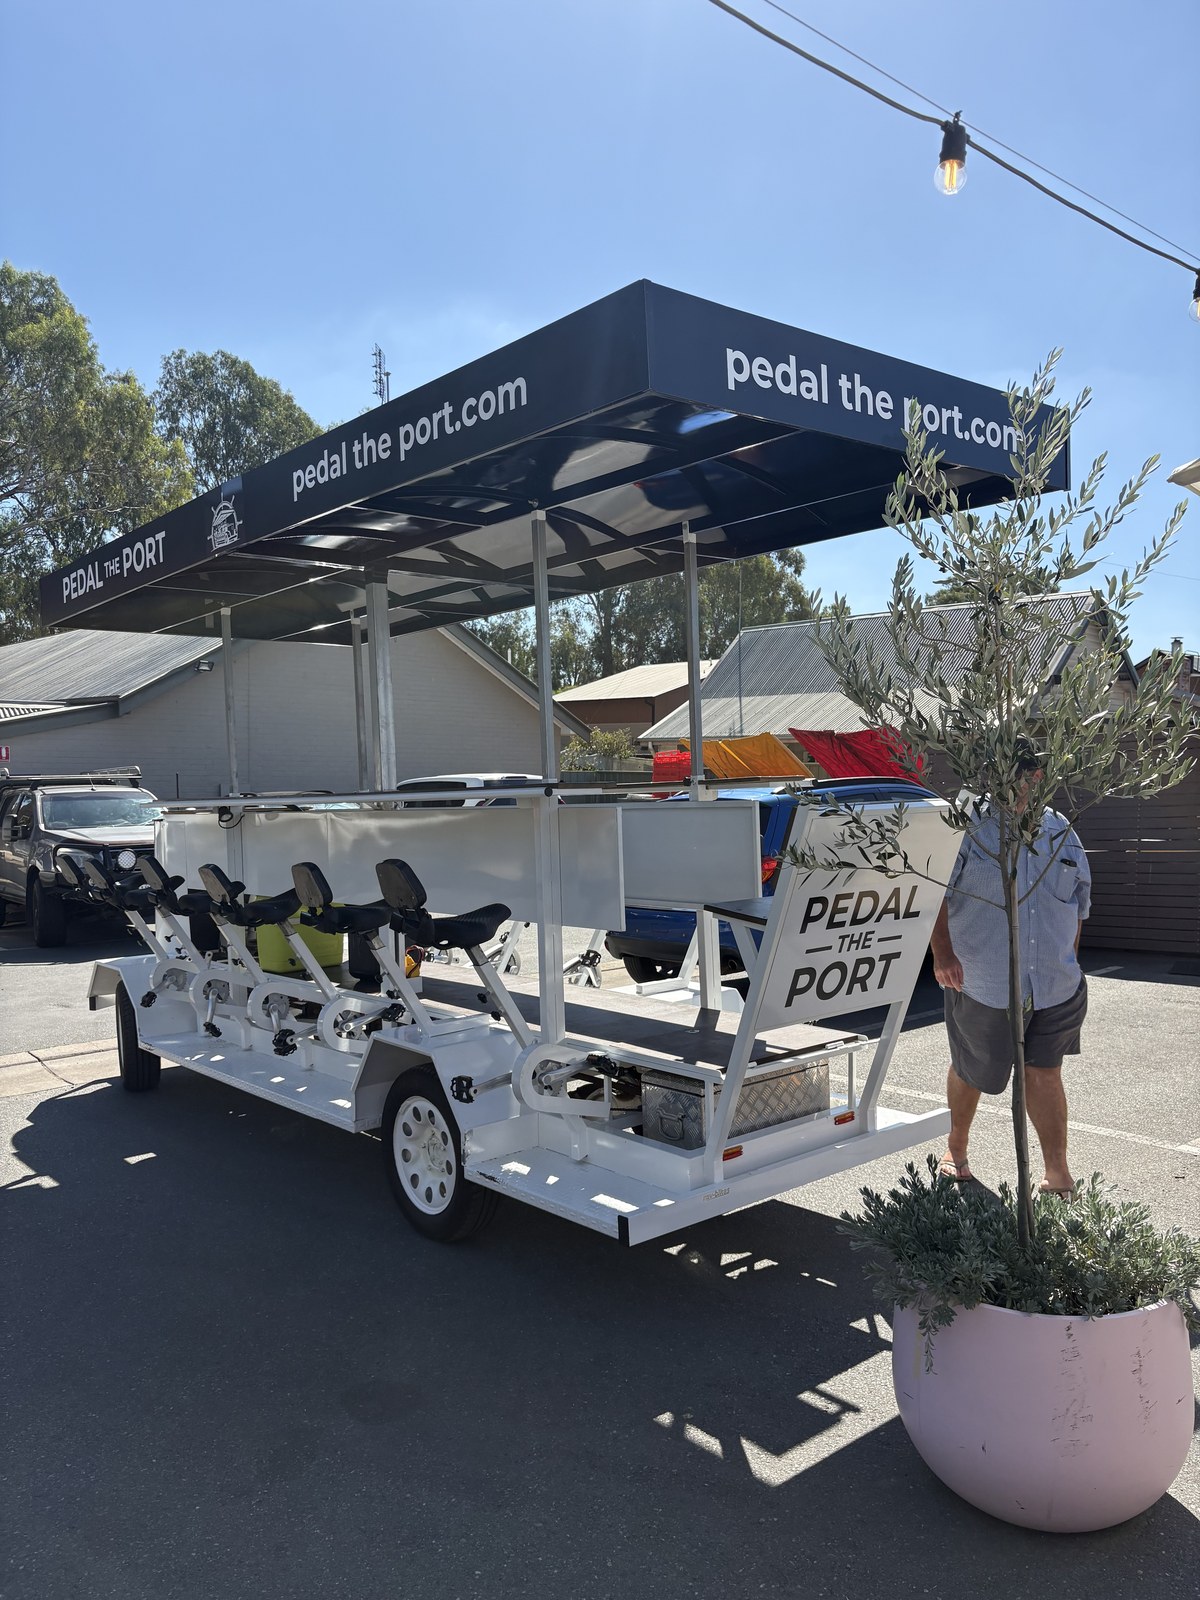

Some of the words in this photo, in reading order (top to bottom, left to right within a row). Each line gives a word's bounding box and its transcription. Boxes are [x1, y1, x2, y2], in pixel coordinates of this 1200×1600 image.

[726, 348, 828, 404] pedal
[838, 373, 894, 420] the
[292, 441, 347, 502] pedal
[352, 432, 392, 470] the
[399, 376, 527, 462] port.com
[62, 561, 104, 604] PEDAL
[103, 556, 120, 578] THE
[122, 530, 166, 578] PORT
[799, 885, 921, 934] PEDAL
[838, 930, 875, 953] THE
[784, 951, 902, 1008] PORT
